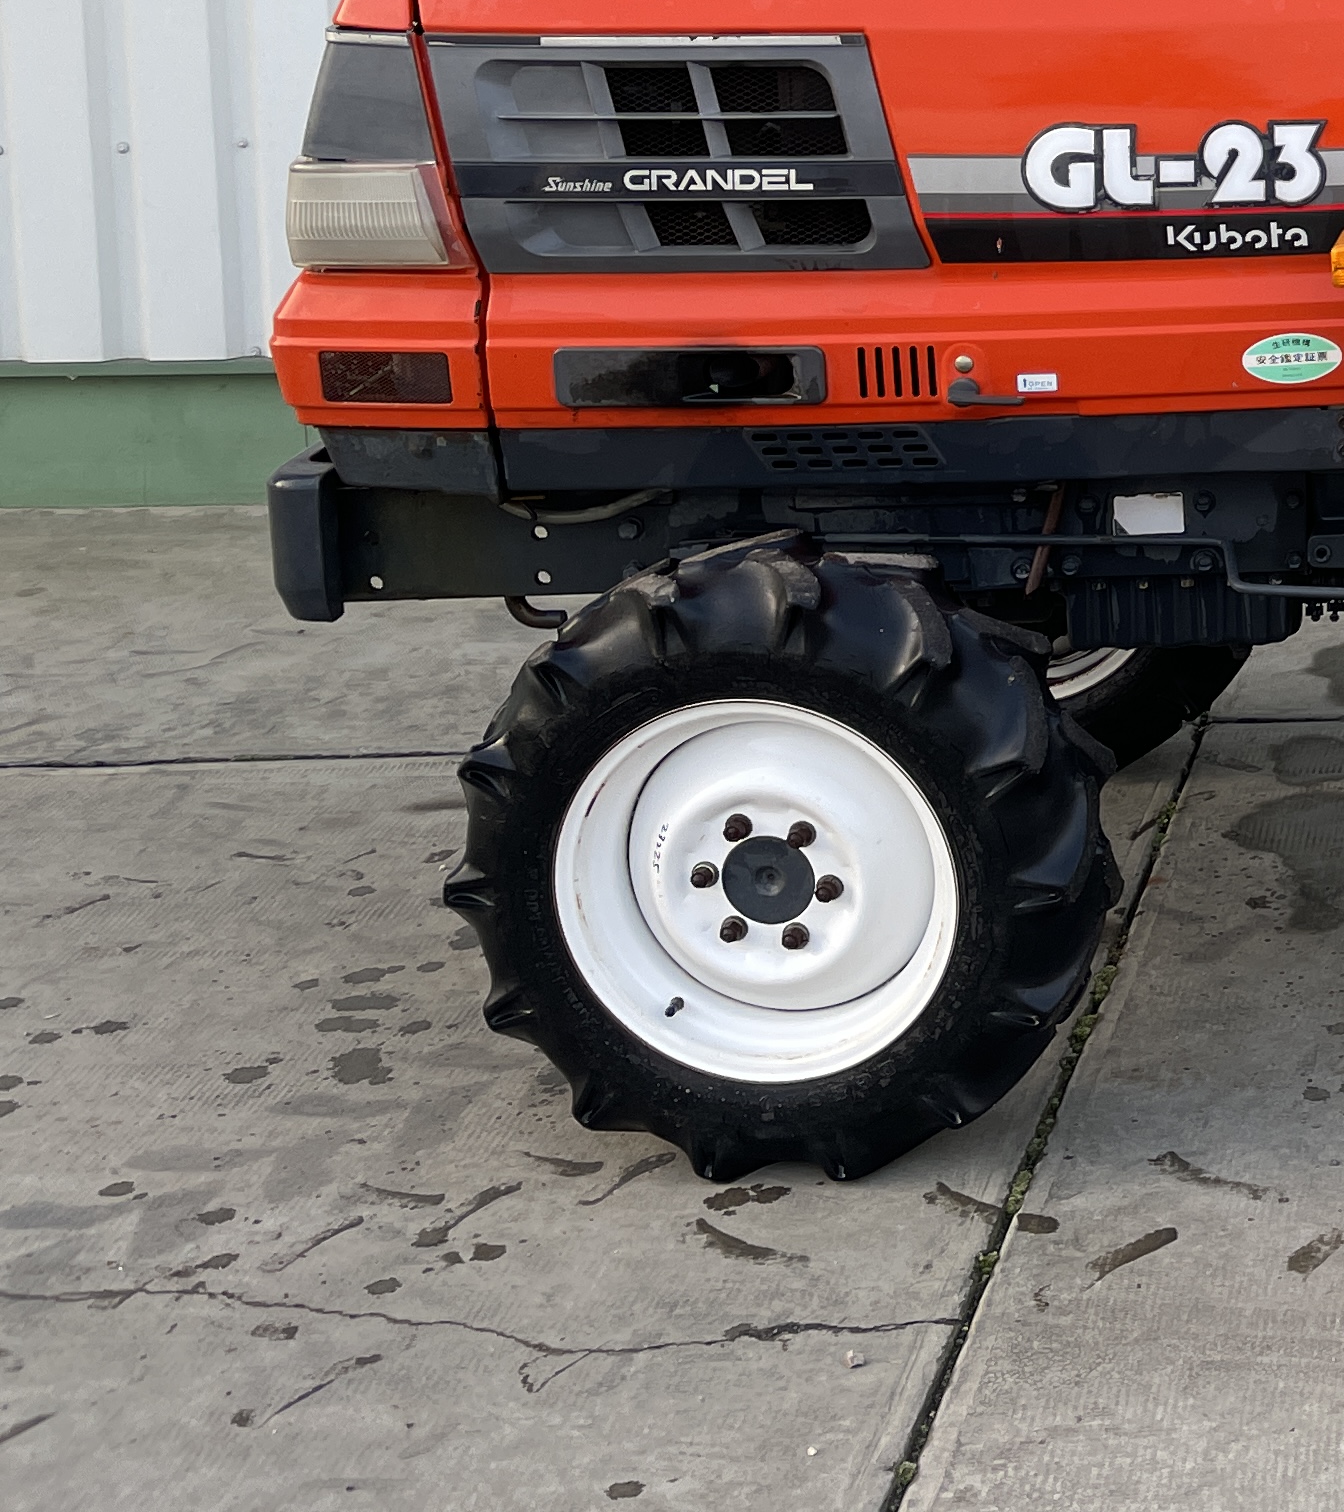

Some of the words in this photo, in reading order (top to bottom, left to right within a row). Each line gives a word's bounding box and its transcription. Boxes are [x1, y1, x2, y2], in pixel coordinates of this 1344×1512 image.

[541, 176, 613, 192] Sunshine
[623, 169, 814, 191] GRANDEL
[1022, 120, 1326, 211] GL-23
[1166, 221, 1309, 252] Kubota
